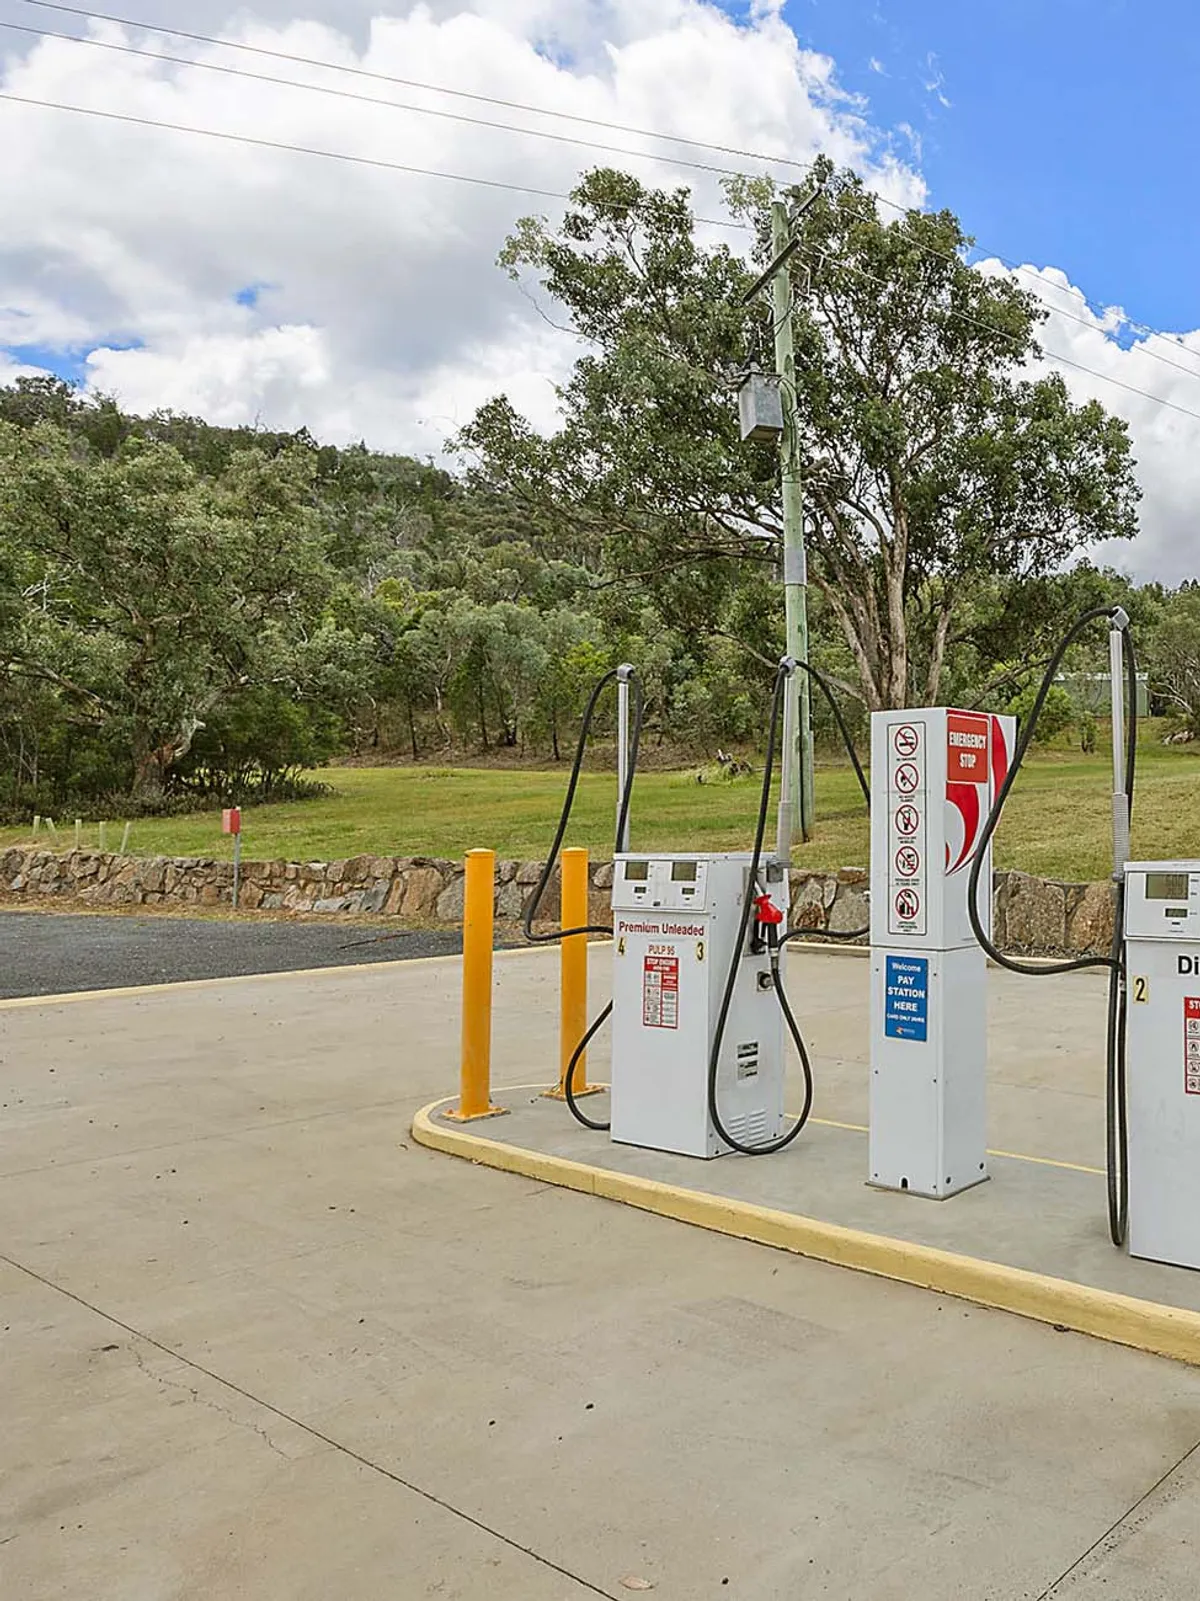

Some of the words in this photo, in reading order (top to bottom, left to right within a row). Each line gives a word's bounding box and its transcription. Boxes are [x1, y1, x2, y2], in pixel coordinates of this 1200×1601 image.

[949, 731, 987, 750] EMERGENCY
[960, 753, 976, 769] STOP
[619, 921, 660, 934] Premium
[661, 923, 705, 937] Unleaded
[617, 937, 626, 956] 4
[648, 944, 665, 955] PULP
[696, 941, 704, 961] 3
[891, 962, 921, 973] Welcome
[897, 975, 915, 986] PAY
[887, 986, 925, 999] STATION
[1135, 978, 1145, 1002] 2
[893, 1001, 918, 1012] HERE
